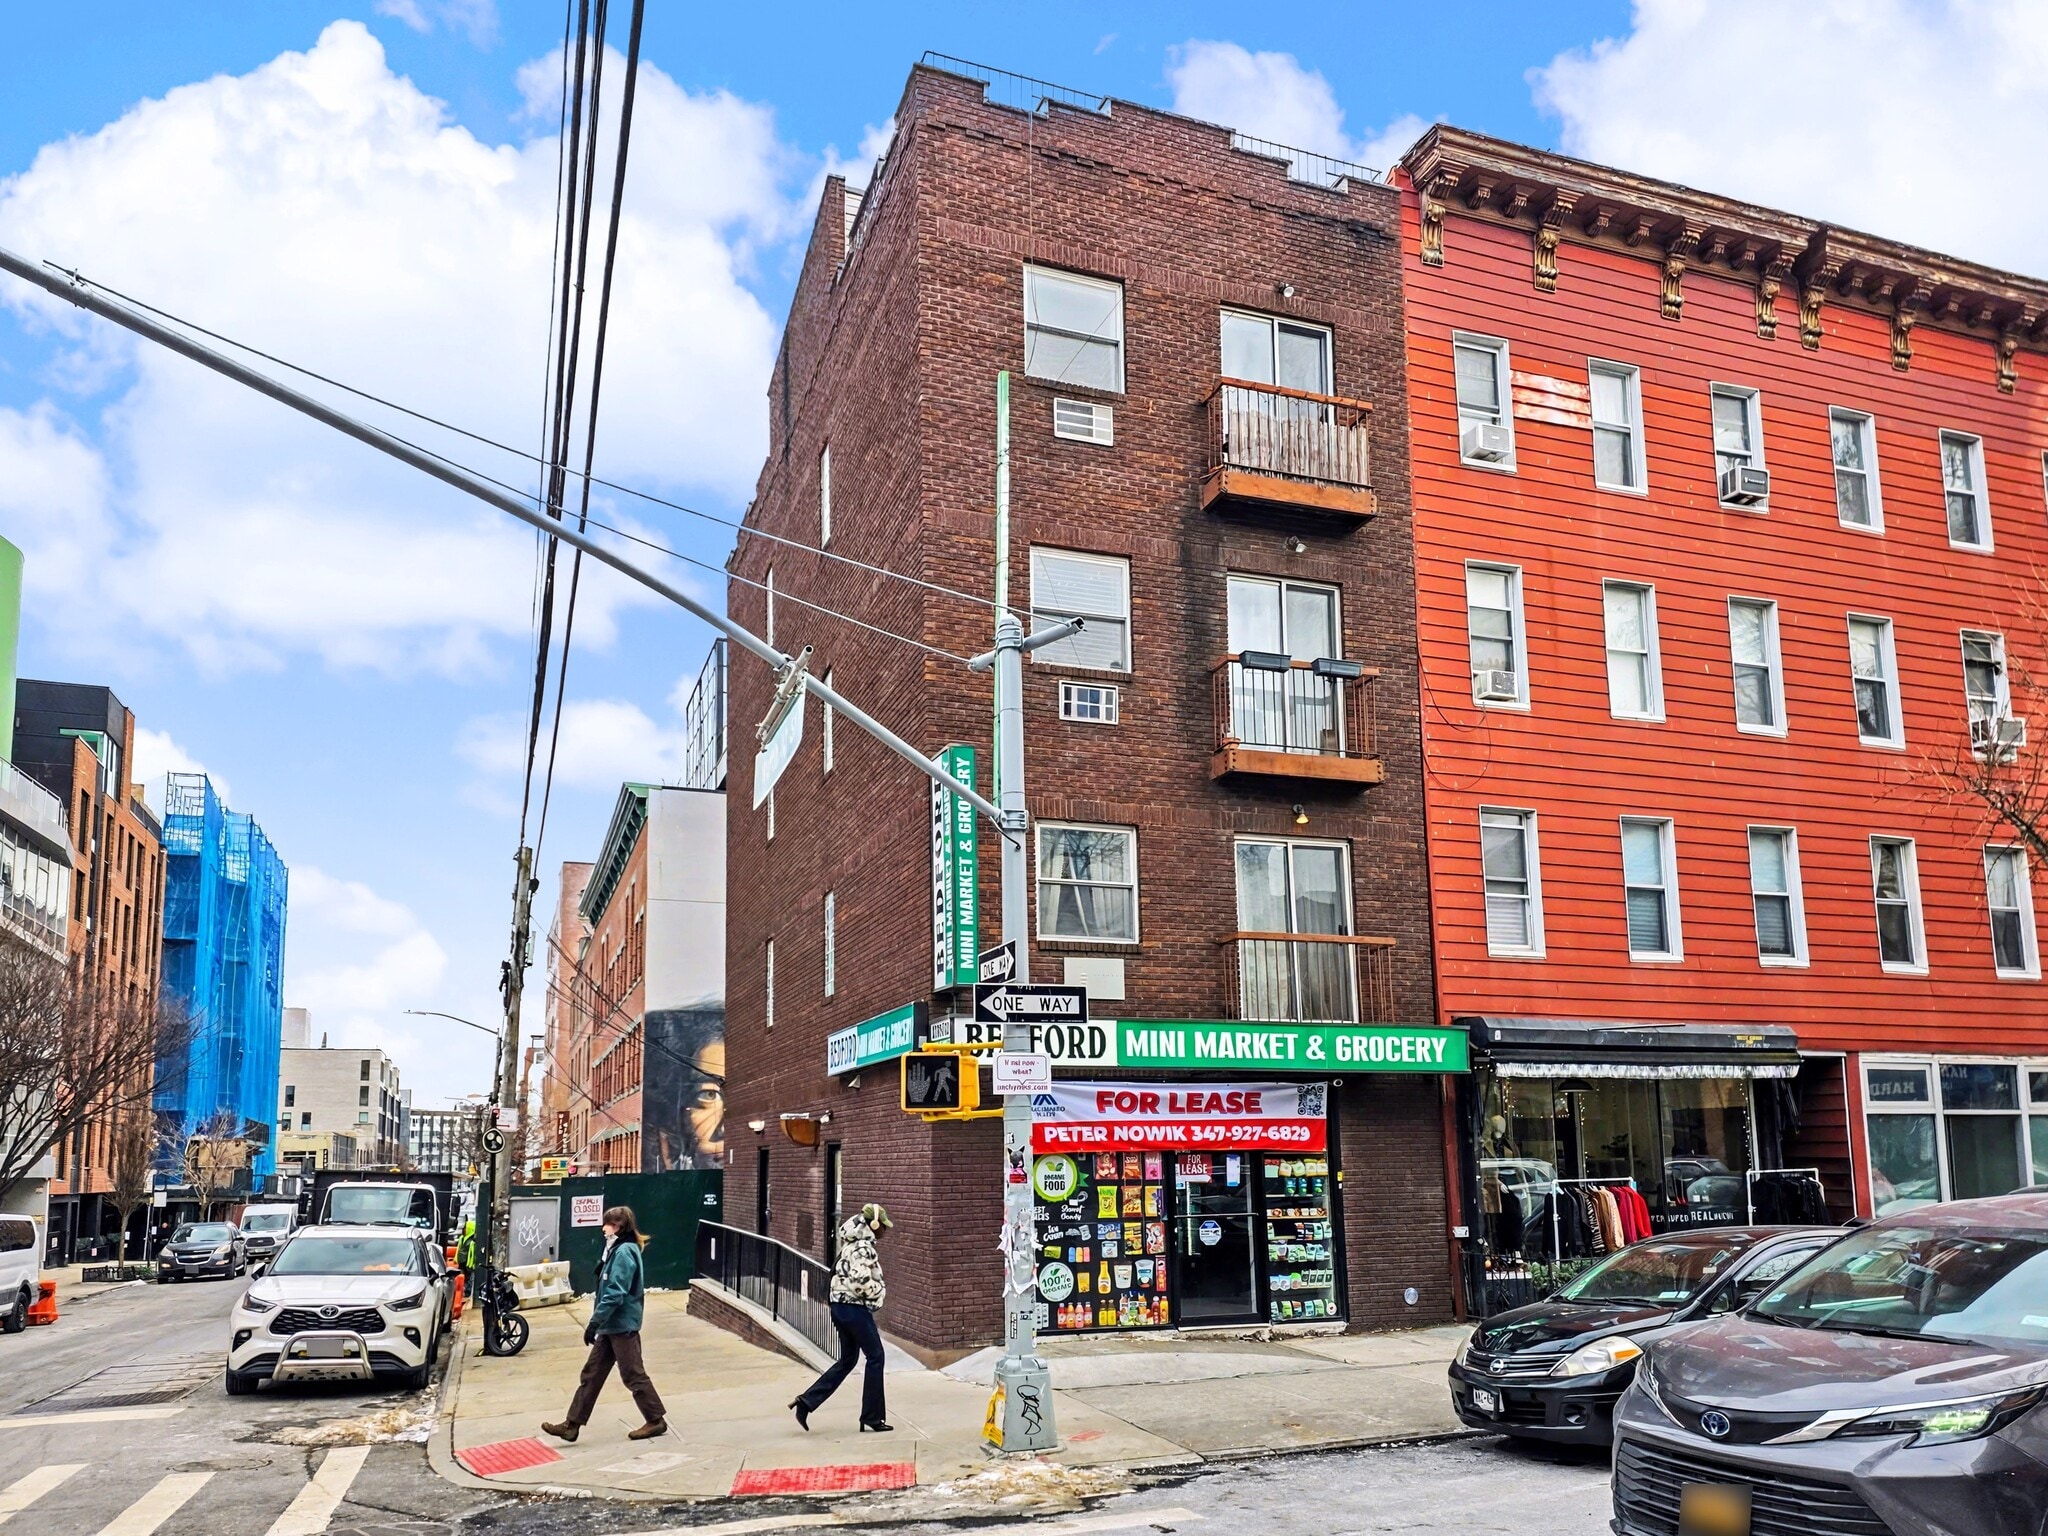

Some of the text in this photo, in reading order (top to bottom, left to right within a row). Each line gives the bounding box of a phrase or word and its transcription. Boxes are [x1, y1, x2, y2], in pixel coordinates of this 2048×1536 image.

[956, 756, 974, 969] MINI MARKET & GROERY
[984, 954, 1010, 978] ONE WAY
[993, 997, 1073, 1012] ONE WAY
[965, 1023, 1447, 1063] BEFORD MINI MARKET & GROCERY
[830, 1034, 857, 1069] BEDFORD
[1096, 1091, 1263, 1115] FOR LEASE
[1044, 1125, 1311, 1143] PETER NOWIK 347-927-6829
[1187, 1154, 1202, 1164] FOR
[1181, 1163, 1208, 1175] LEASE
[1044, 1180, 1065, 1191] FOOD
[1690, 1210, 1714, 1221] REAL
[1042, 1273, 1071, 1288] 100%
